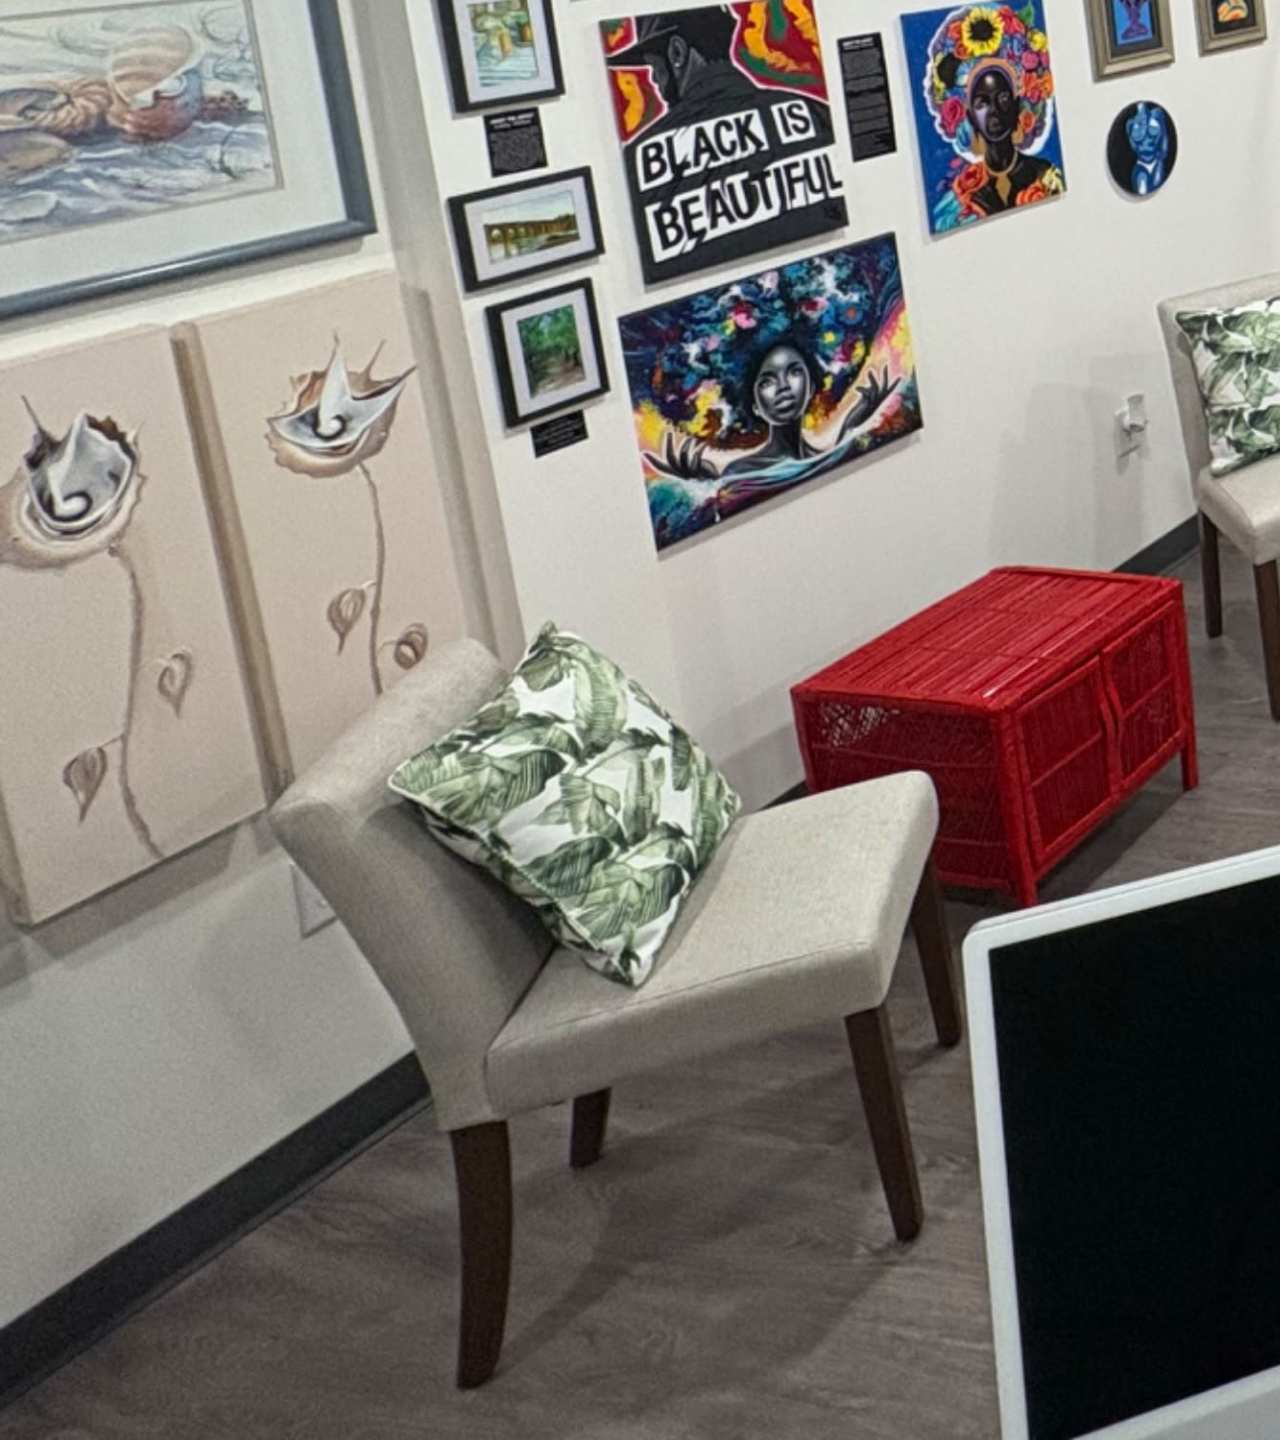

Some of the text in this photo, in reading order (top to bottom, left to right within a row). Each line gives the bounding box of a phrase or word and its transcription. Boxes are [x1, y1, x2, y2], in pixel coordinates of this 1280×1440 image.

[642, 105, 810, 184] BLACK IS
[653, 153, 843, 251] BEAUTIFUL
